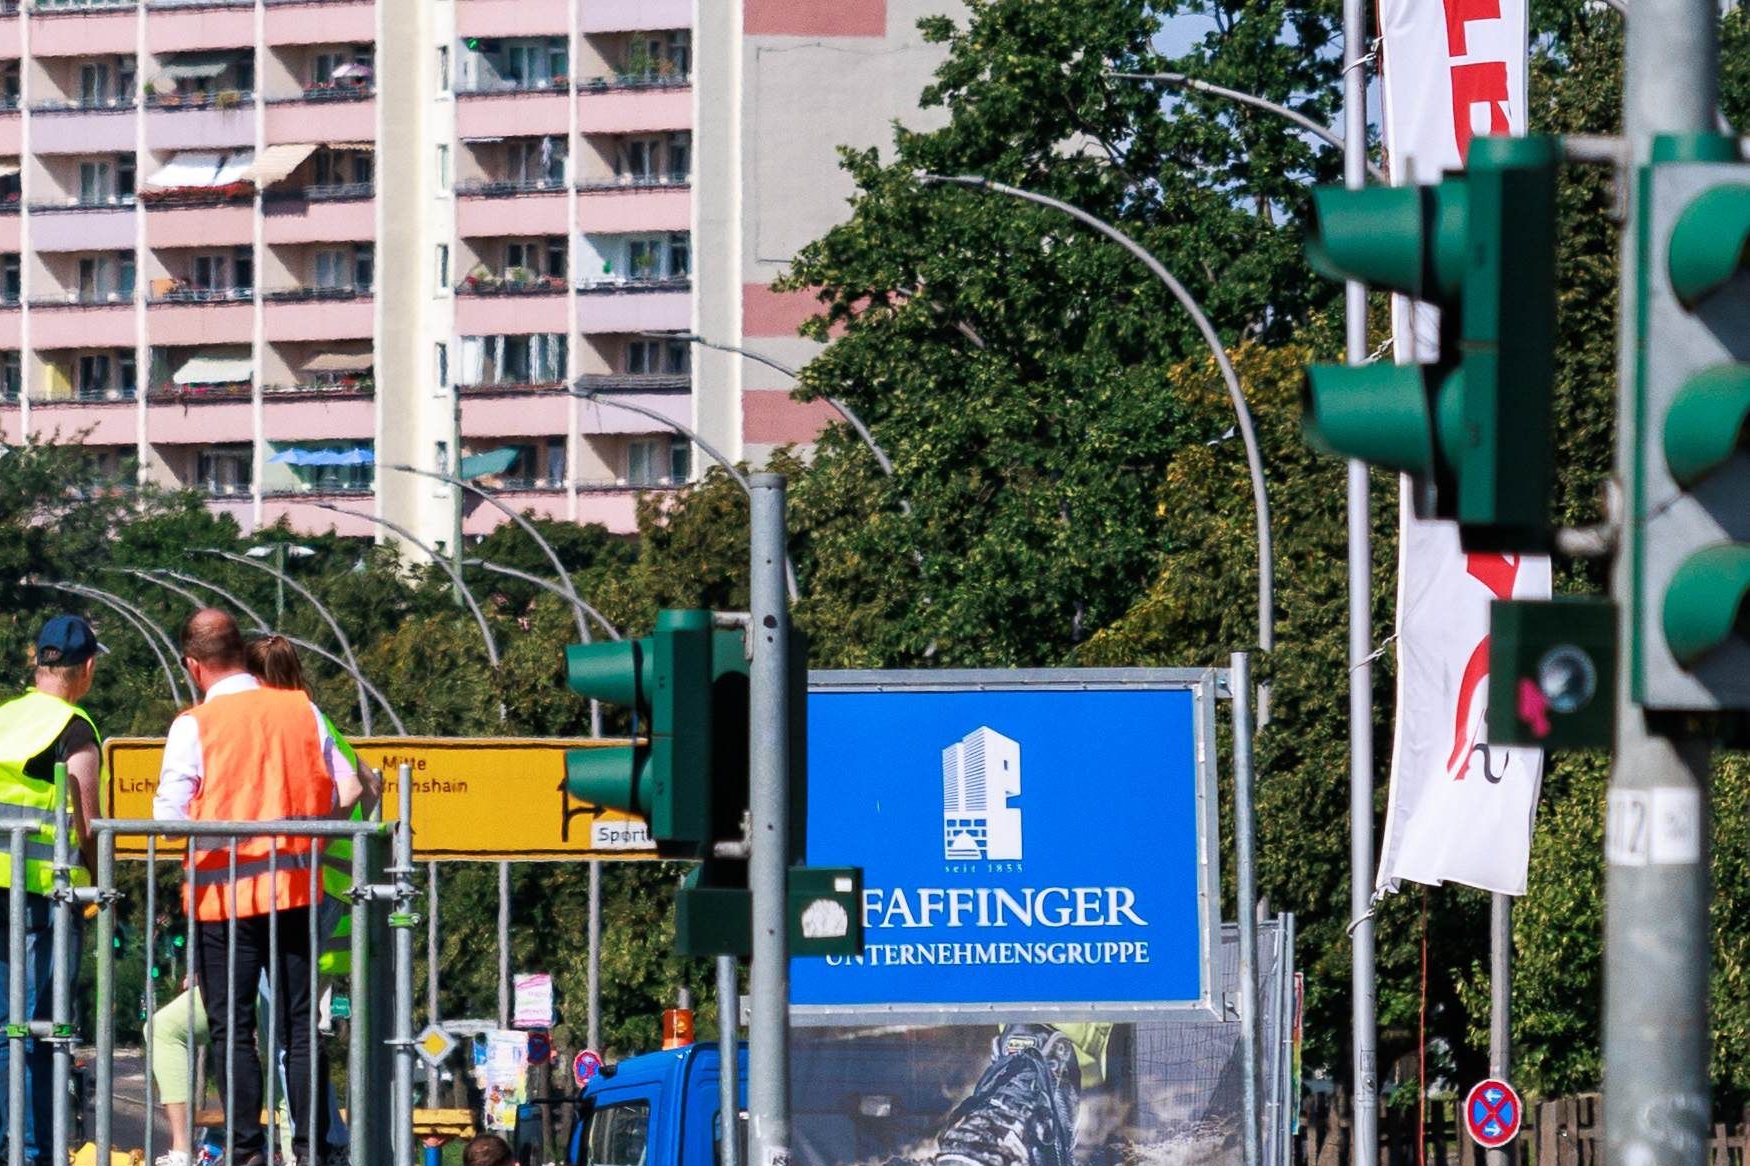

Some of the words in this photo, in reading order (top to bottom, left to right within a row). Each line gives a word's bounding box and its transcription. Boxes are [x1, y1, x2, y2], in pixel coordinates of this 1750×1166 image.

[119, 777, 160, 793] Lich
[597, 826, 654, 845] Sport
[945, 863, 976, 873] seit
[862, 886, 1149, 928] FAFFINGER
[826, 942, 1149, 967] UNTERNEHMENSGRUPPE
